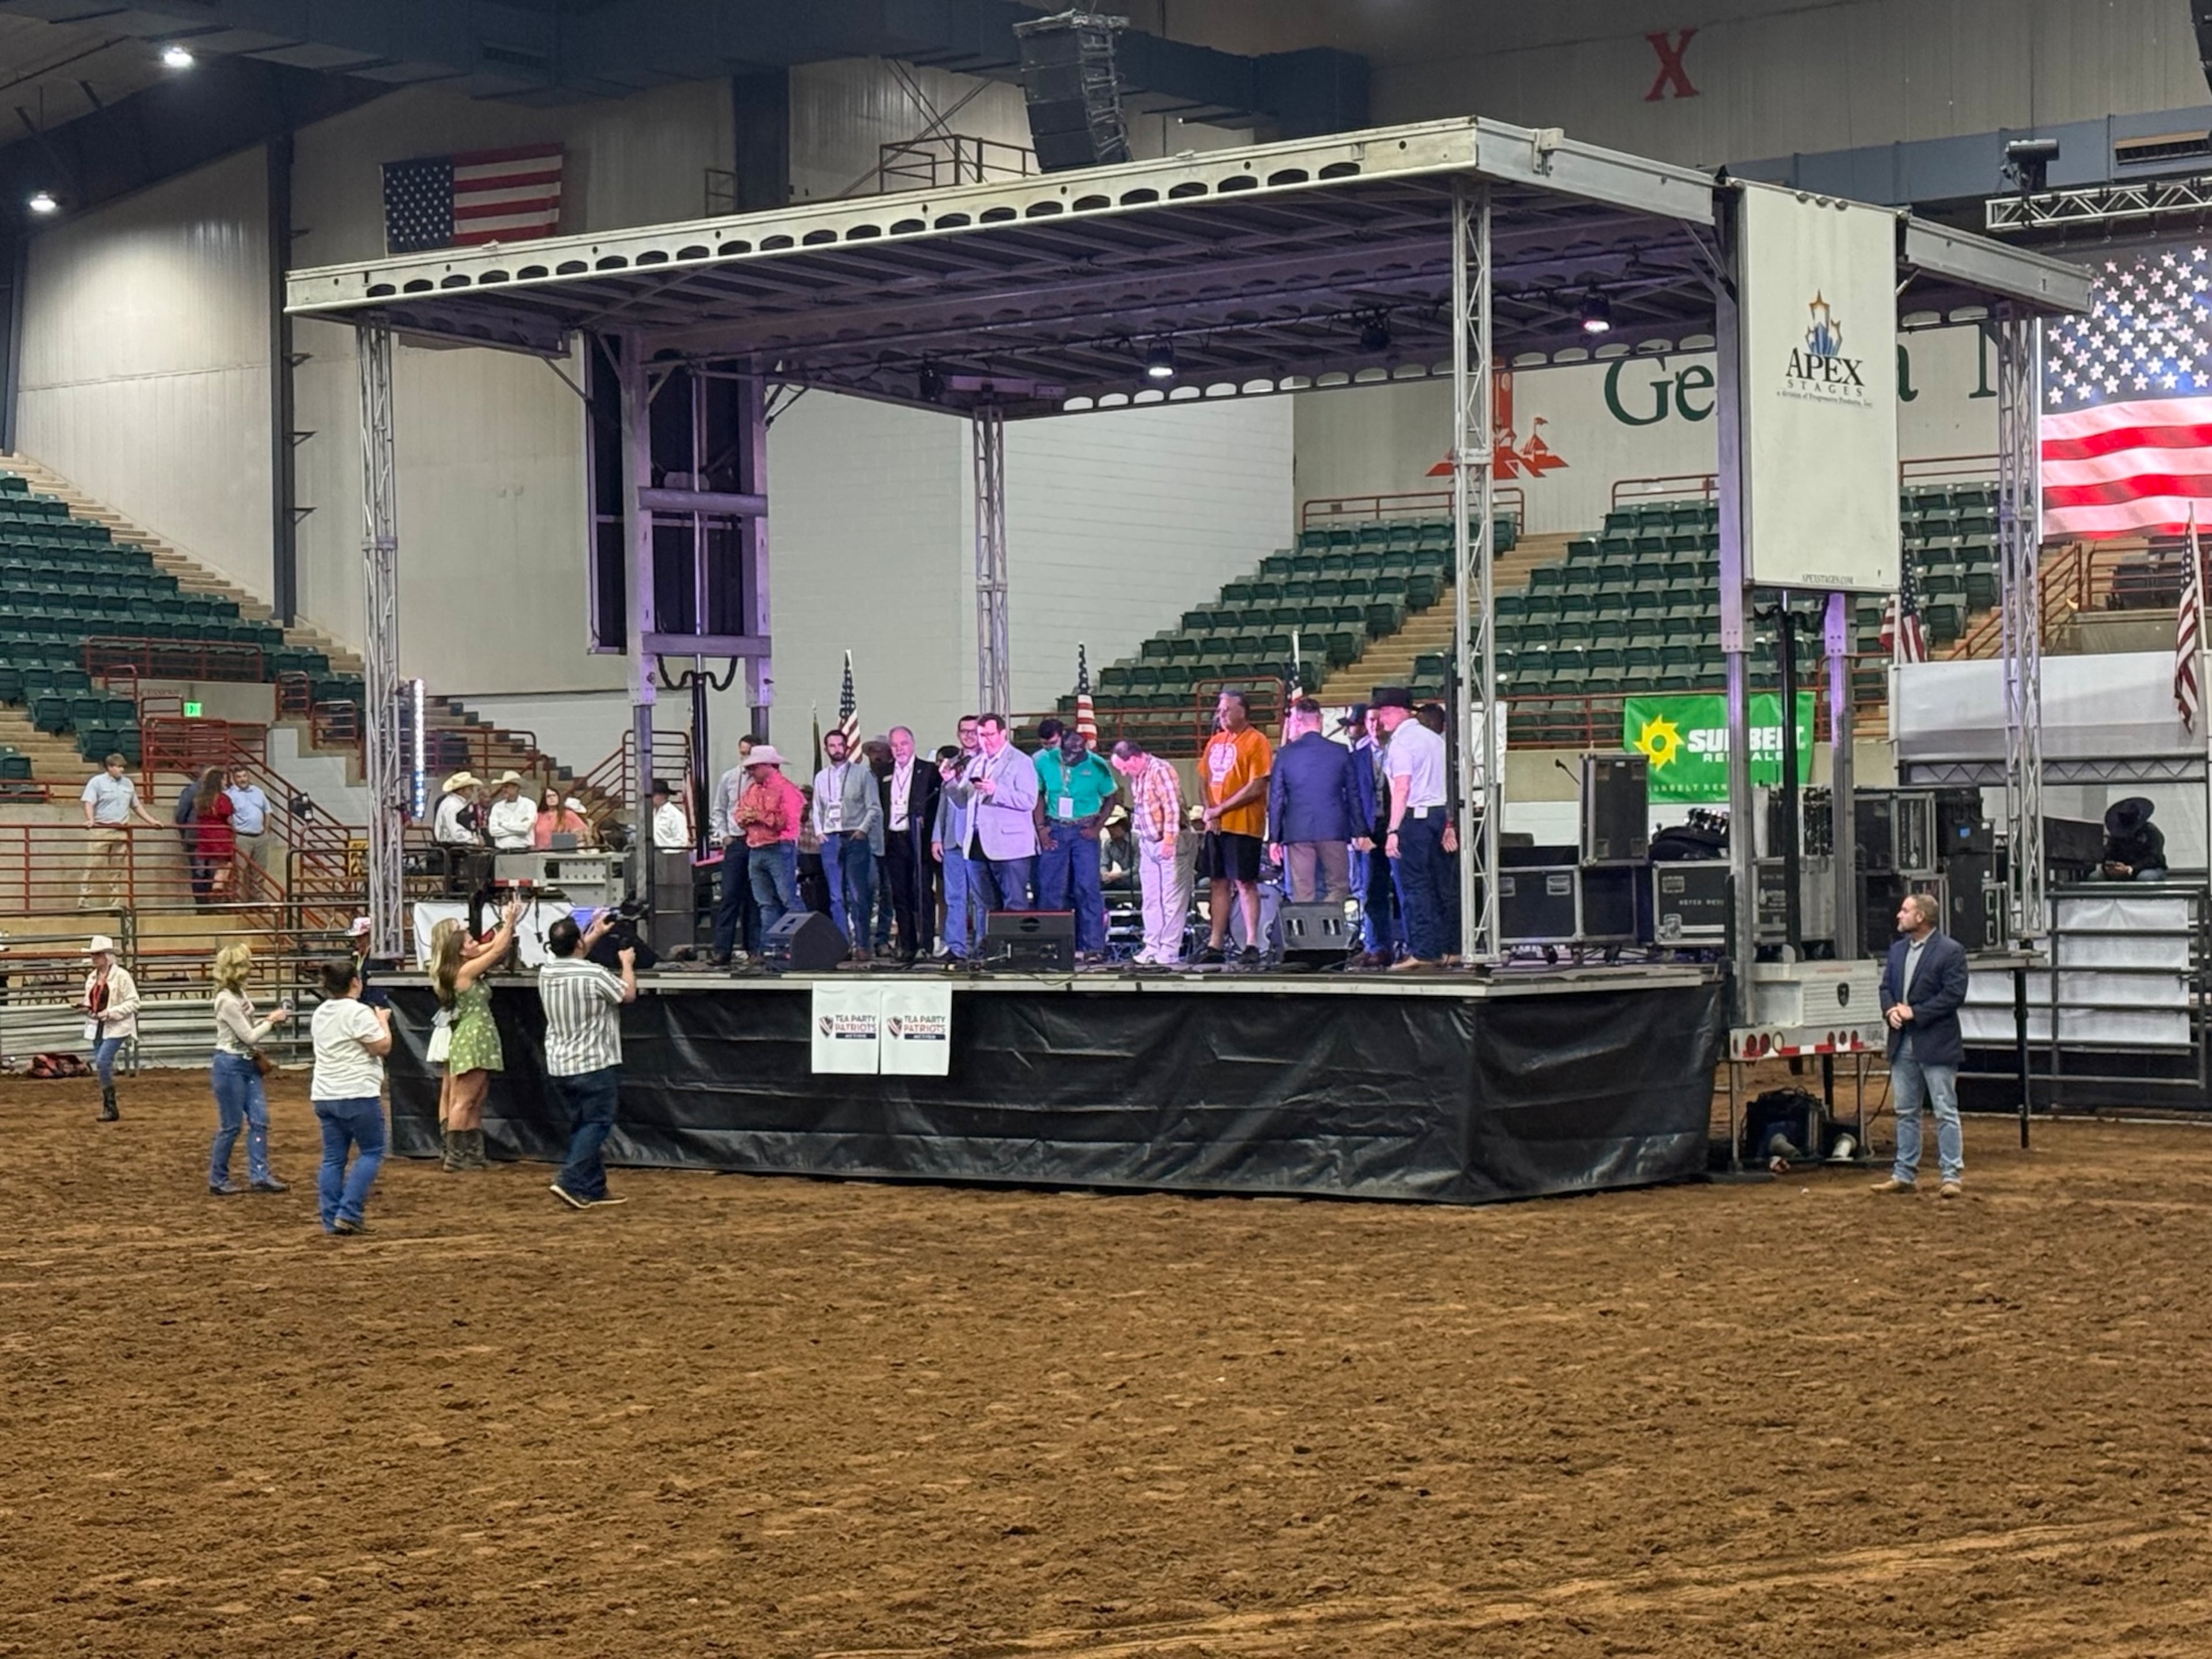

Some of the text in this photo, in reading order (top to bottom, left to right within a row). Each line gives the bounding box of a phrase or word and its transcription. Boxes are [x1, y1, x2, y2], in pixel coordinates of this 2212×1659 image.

[1645, 28, 1700, 102] X
[1786, 347, 1865, 387] APEX
[1787, 379, 1862, 397] STAGES
[835, 1014, 877, 1022] TEA PARTY
[920, 1015, 946, 1023] PARTY
[835, 1023, 877, 1032] PATRIOTS
[904, 1024, 946, 1033] PATRIOTS
